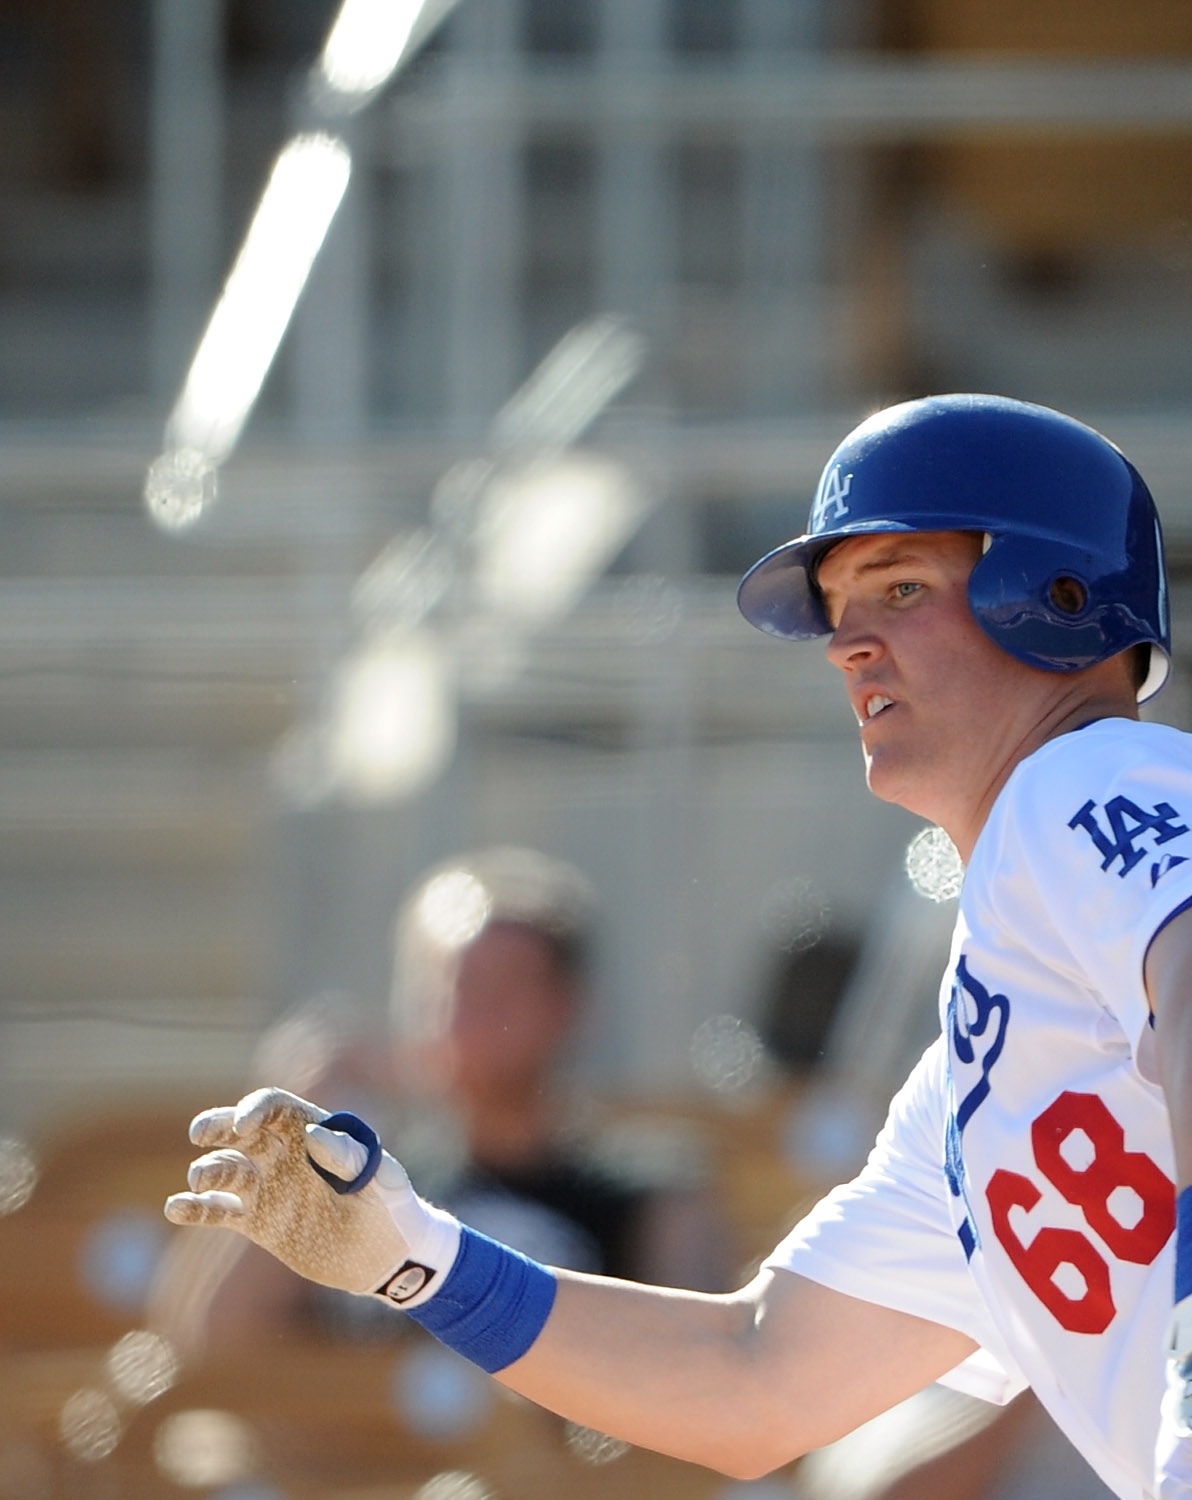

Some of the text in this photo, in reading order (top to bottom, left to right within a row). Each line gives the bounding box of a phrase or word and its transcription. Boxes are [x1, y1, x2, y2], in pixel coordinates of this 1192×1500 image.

[813, 463, 854, 533] LA
[1067, 795, 1190, 878] LA
[985, 1090, 1177, 1335] 68
